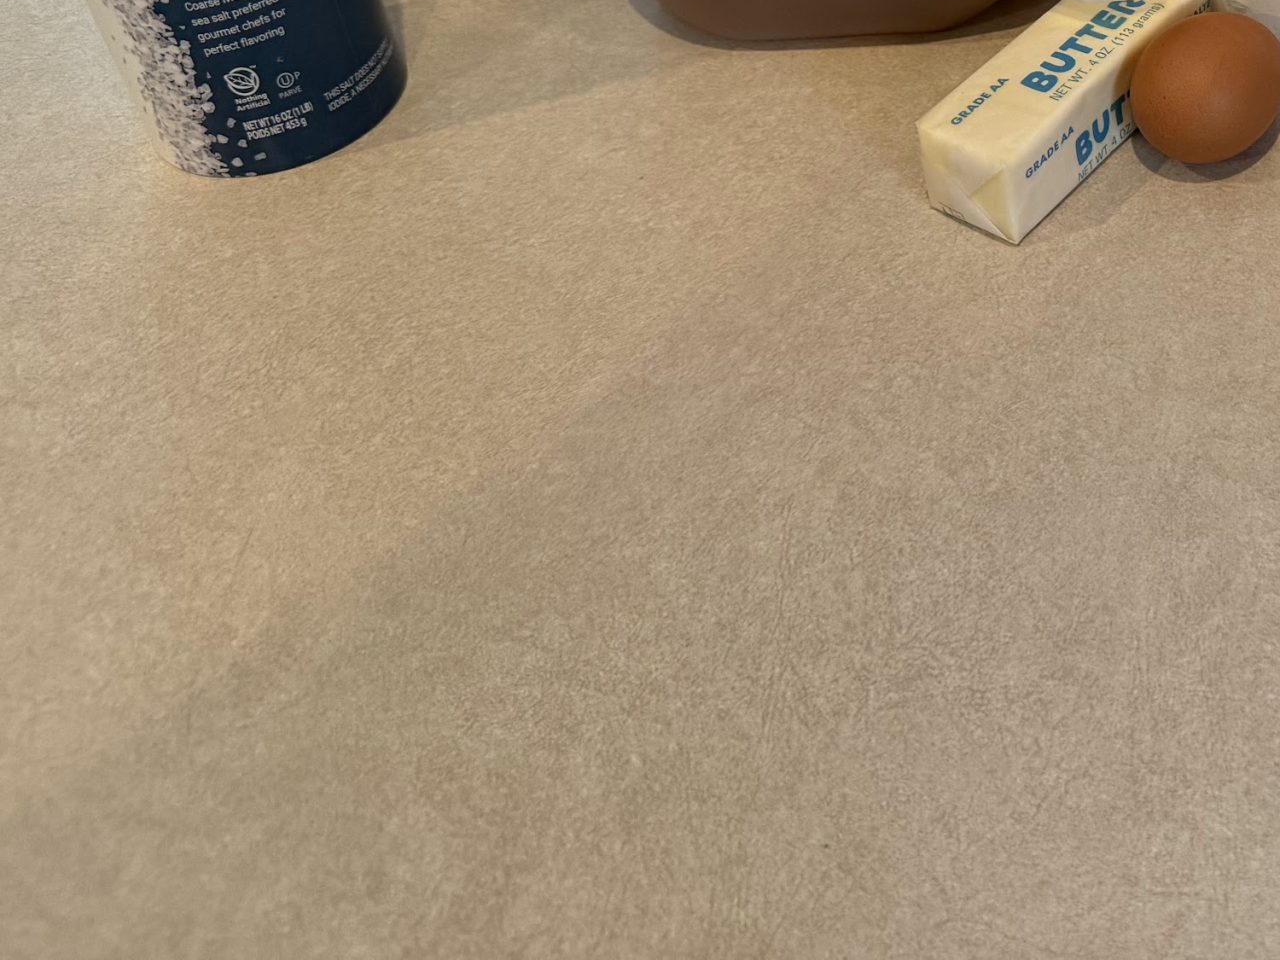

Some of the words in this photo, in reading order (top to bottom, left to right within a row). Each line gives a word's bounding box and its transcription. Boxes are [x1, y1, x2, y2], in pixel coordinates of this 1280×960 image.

[191, 15, 211, 27] sea
[211, 11, 232, 23] salt
[197, 24, 242, 43] gourmet
[242, 14, 271, 31] chefs
[271, 8, 286, 20] for
[203, 41, 241, 58] perfect
[240, 26, 286, 48] flavoring
[1049, 82, 1073, 101] NET
[1068, 66, 1093, 89] WT.
[1090, 58, 1099, 67] 4
[1113, 26, 1135, 46] (113
[1132, 2, 1166, 28] grams)
[235, 92, 269, 105] Nothing
[278, 85, 303, 100] PARVE
[323, 86, 341, 101] THIS
[339, 75, 355, 92] SALT
[950, 91, 992, 126] GRADE
[989, 77, 1010, 94] AA
[236, 99, 271, 112] Artificial
[242, 119, 259, 131] NET
[257, 117, 271, 130] WT
[270, 115, 282, 126] 16
[281, 109, 294, 122] OZ
[293, 106, 301, 119] (1
[300, 101, 314, 115] LB)
[246, 127, 271, 141] POIDS
[270, 123, 285, 136] NET
[285, 119, 301, 132] 453
[300, 117, 308, 128] g
[1024, 141, 1060, 180] GRADE
[1059, 125, 1075, 145] AA
[1077, 162, 1094, 182] NET
[1110, 135, 1119, 146] 4
